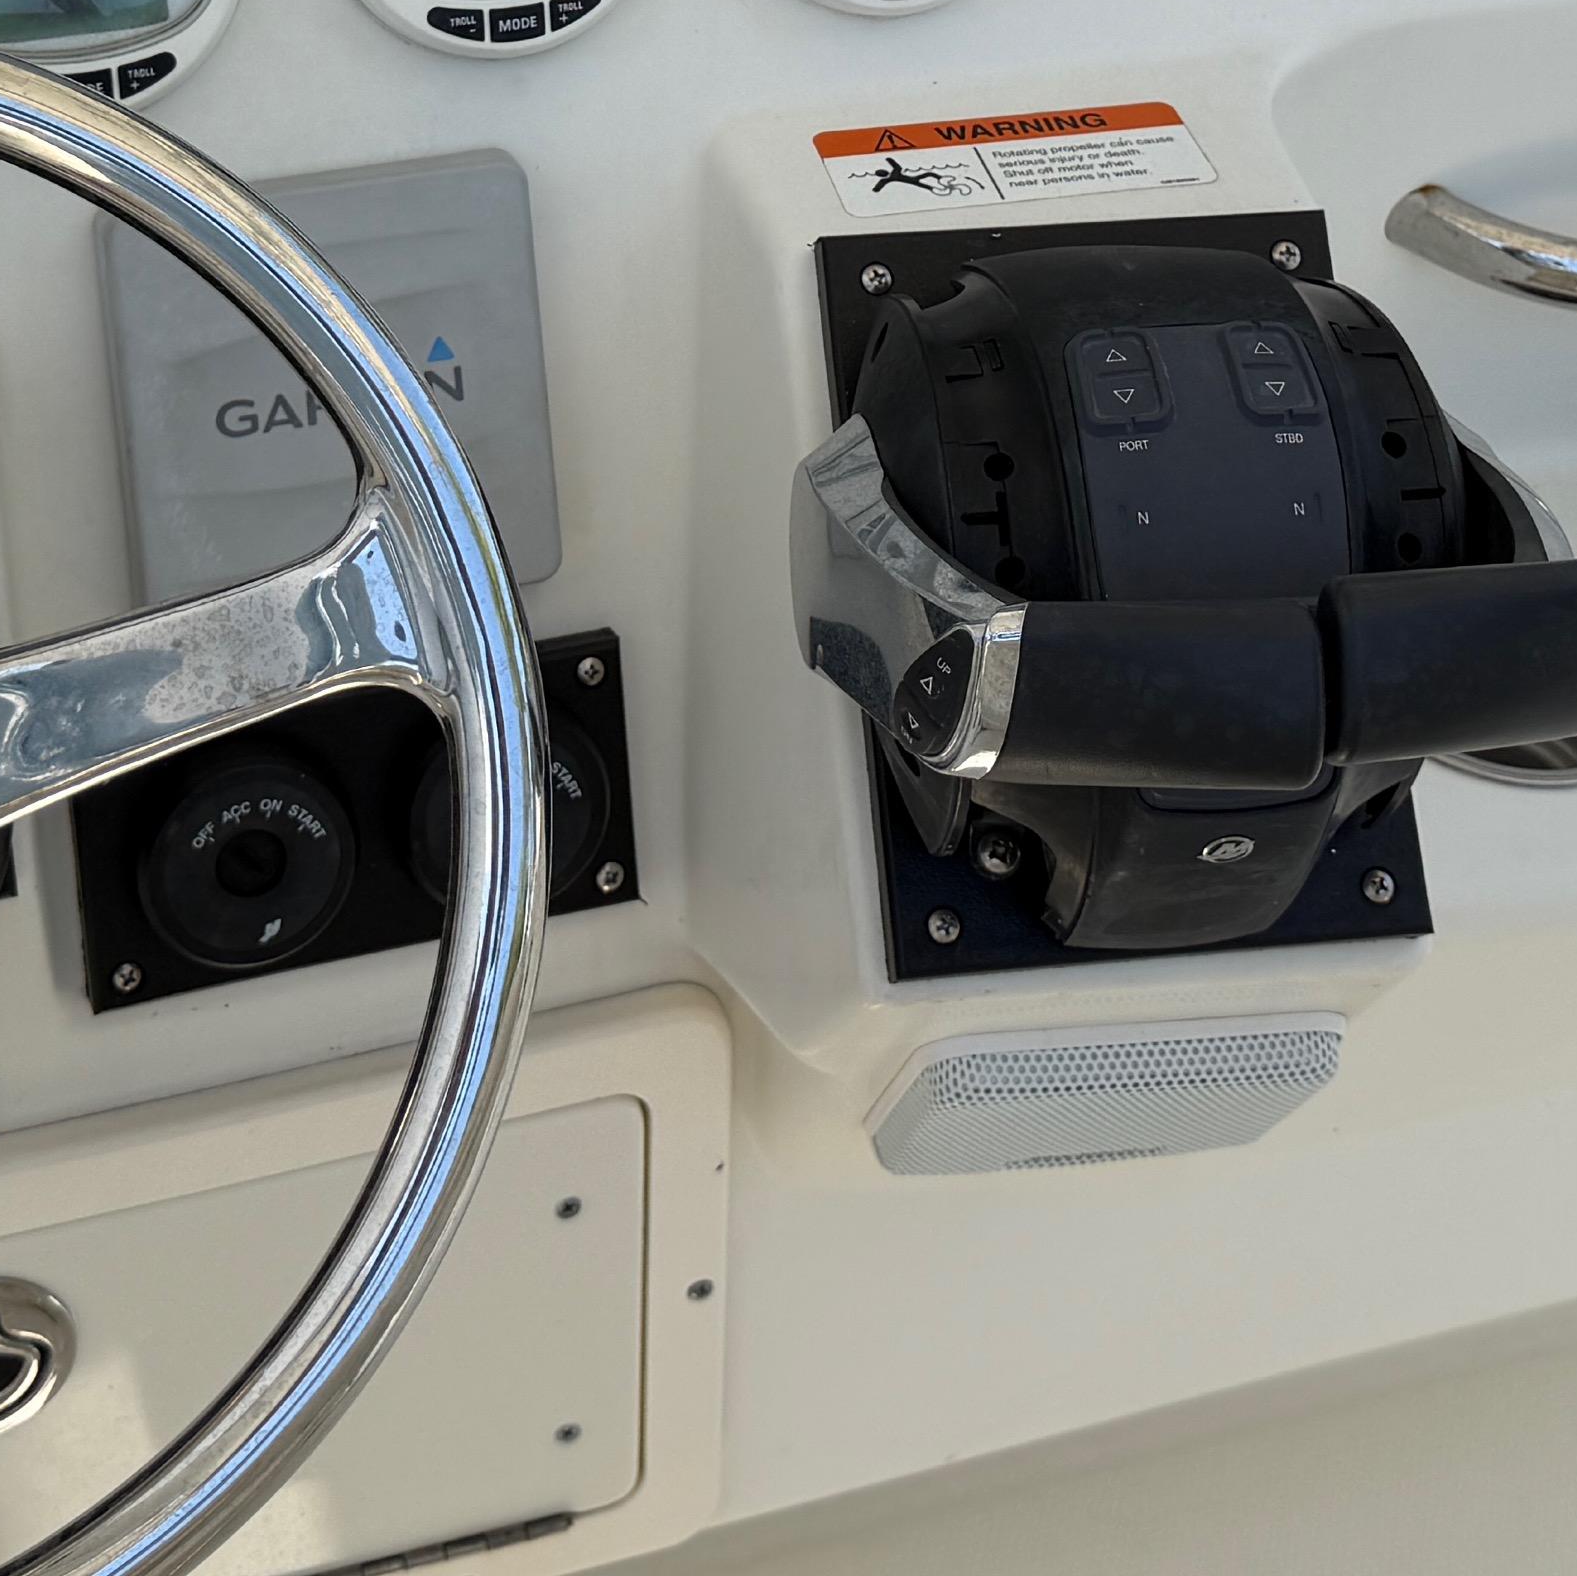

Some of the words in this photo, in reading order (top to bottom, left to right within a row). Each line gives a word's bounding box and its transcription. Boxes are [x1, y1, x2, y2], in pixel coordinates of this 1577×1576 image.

[557, 0, 583, 12] TROLL
[450, 15, 477, 27] TROLL
[498, 15, 538, 32] MODE
[128, 67, 155, 79] TROLL
[935, 113, 1108, 141] WARNING
[992, 148, 1047, 159] Rotating
[1051, 142, 1105, 155] propeller
[1109, 139, 1133, 148] can
[1136, 135, 1174, 145] cause
[998, 158, 1046, 168] serious
[1048, 154, 1084, 165] injury
[1087, 152, 1101, 160] or
[1003, 168, 1035, 178] Shut
[1057, 163, 1095, 173] motor
[1099, 159, 1134, 169] when
[1009, 179, 1039, 188] near
[1275, 433, 1304, 444] STBD
[1119, 440, 1149, 452] PORT
[1293, 503, 1305, 515] N
[1137, 512, 1149, 524] N
[936, 657, 952, 674] UP
[552, 762, 582, 800] START
[193, 821, 215, 849] OFF
[221, 801, 251, 823] ACC
[260, 798, 283, 812] ON
[288, 804, 327, 839] START
